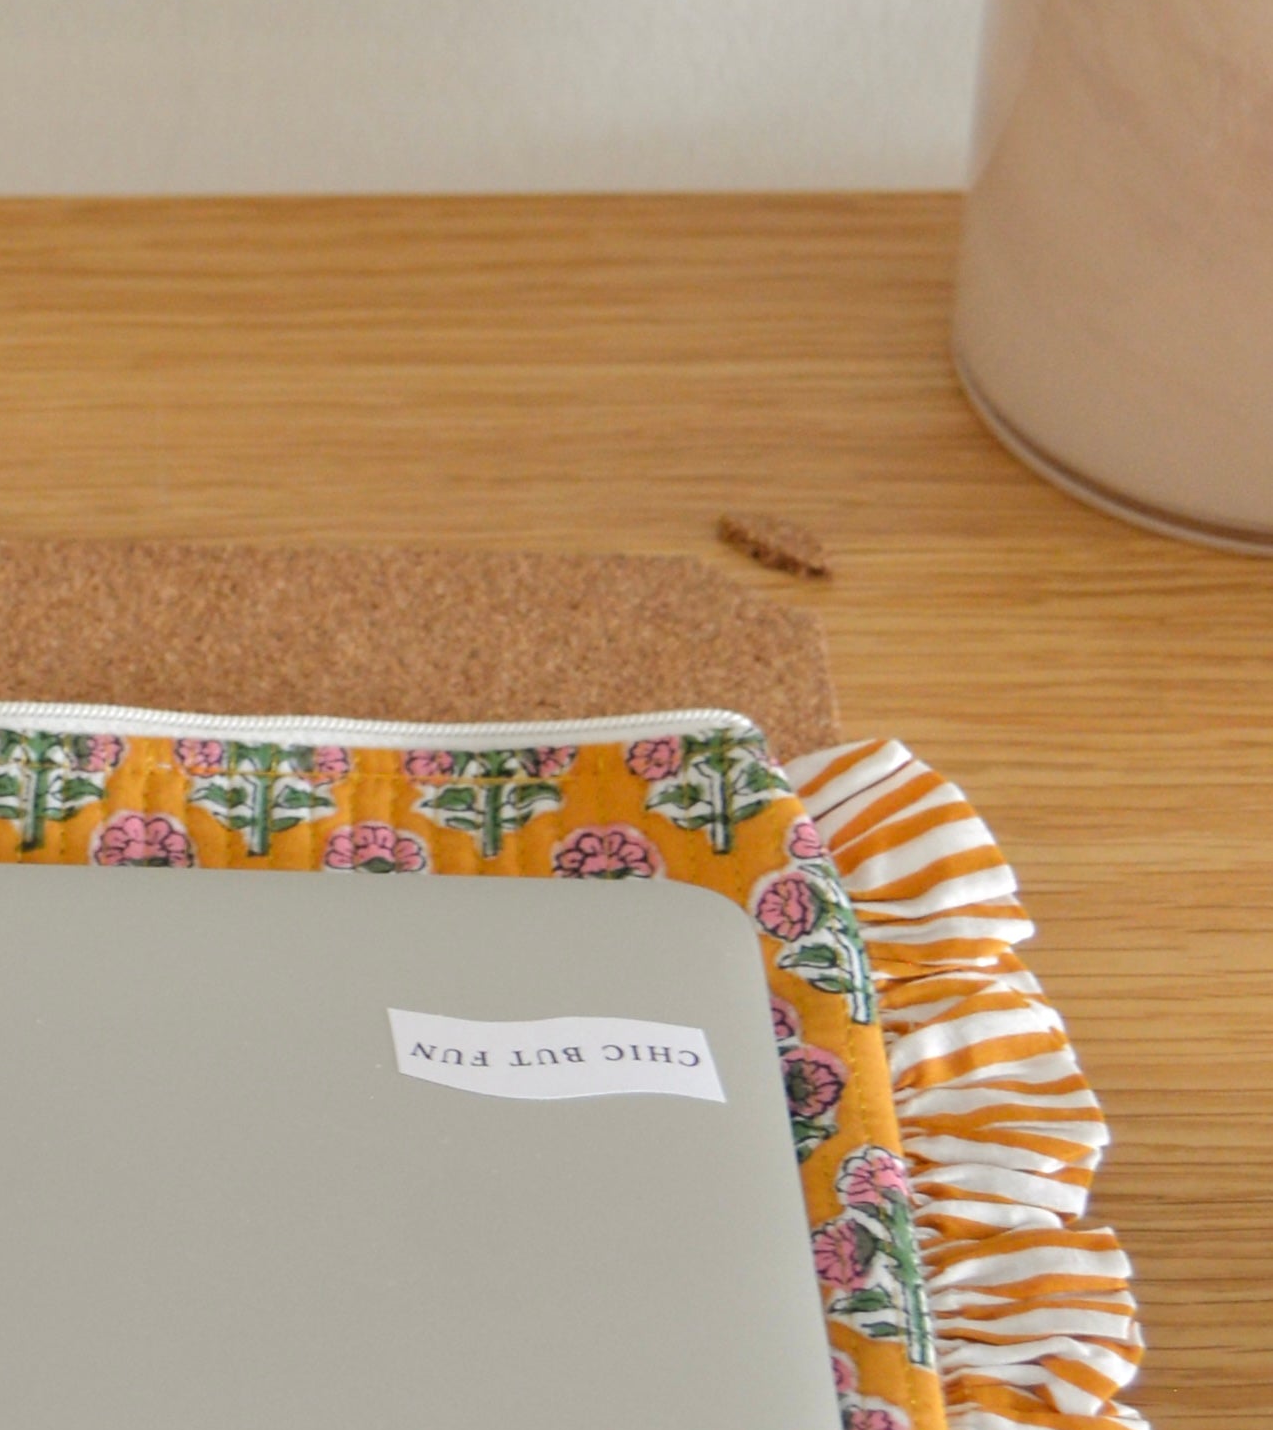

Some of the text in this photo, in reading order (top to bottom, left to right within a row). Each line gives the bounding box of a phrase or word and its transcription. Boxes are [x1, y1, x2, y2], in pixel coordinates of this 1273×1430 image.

[409, 1040, 703, 1069] CHIC BUT FUN
